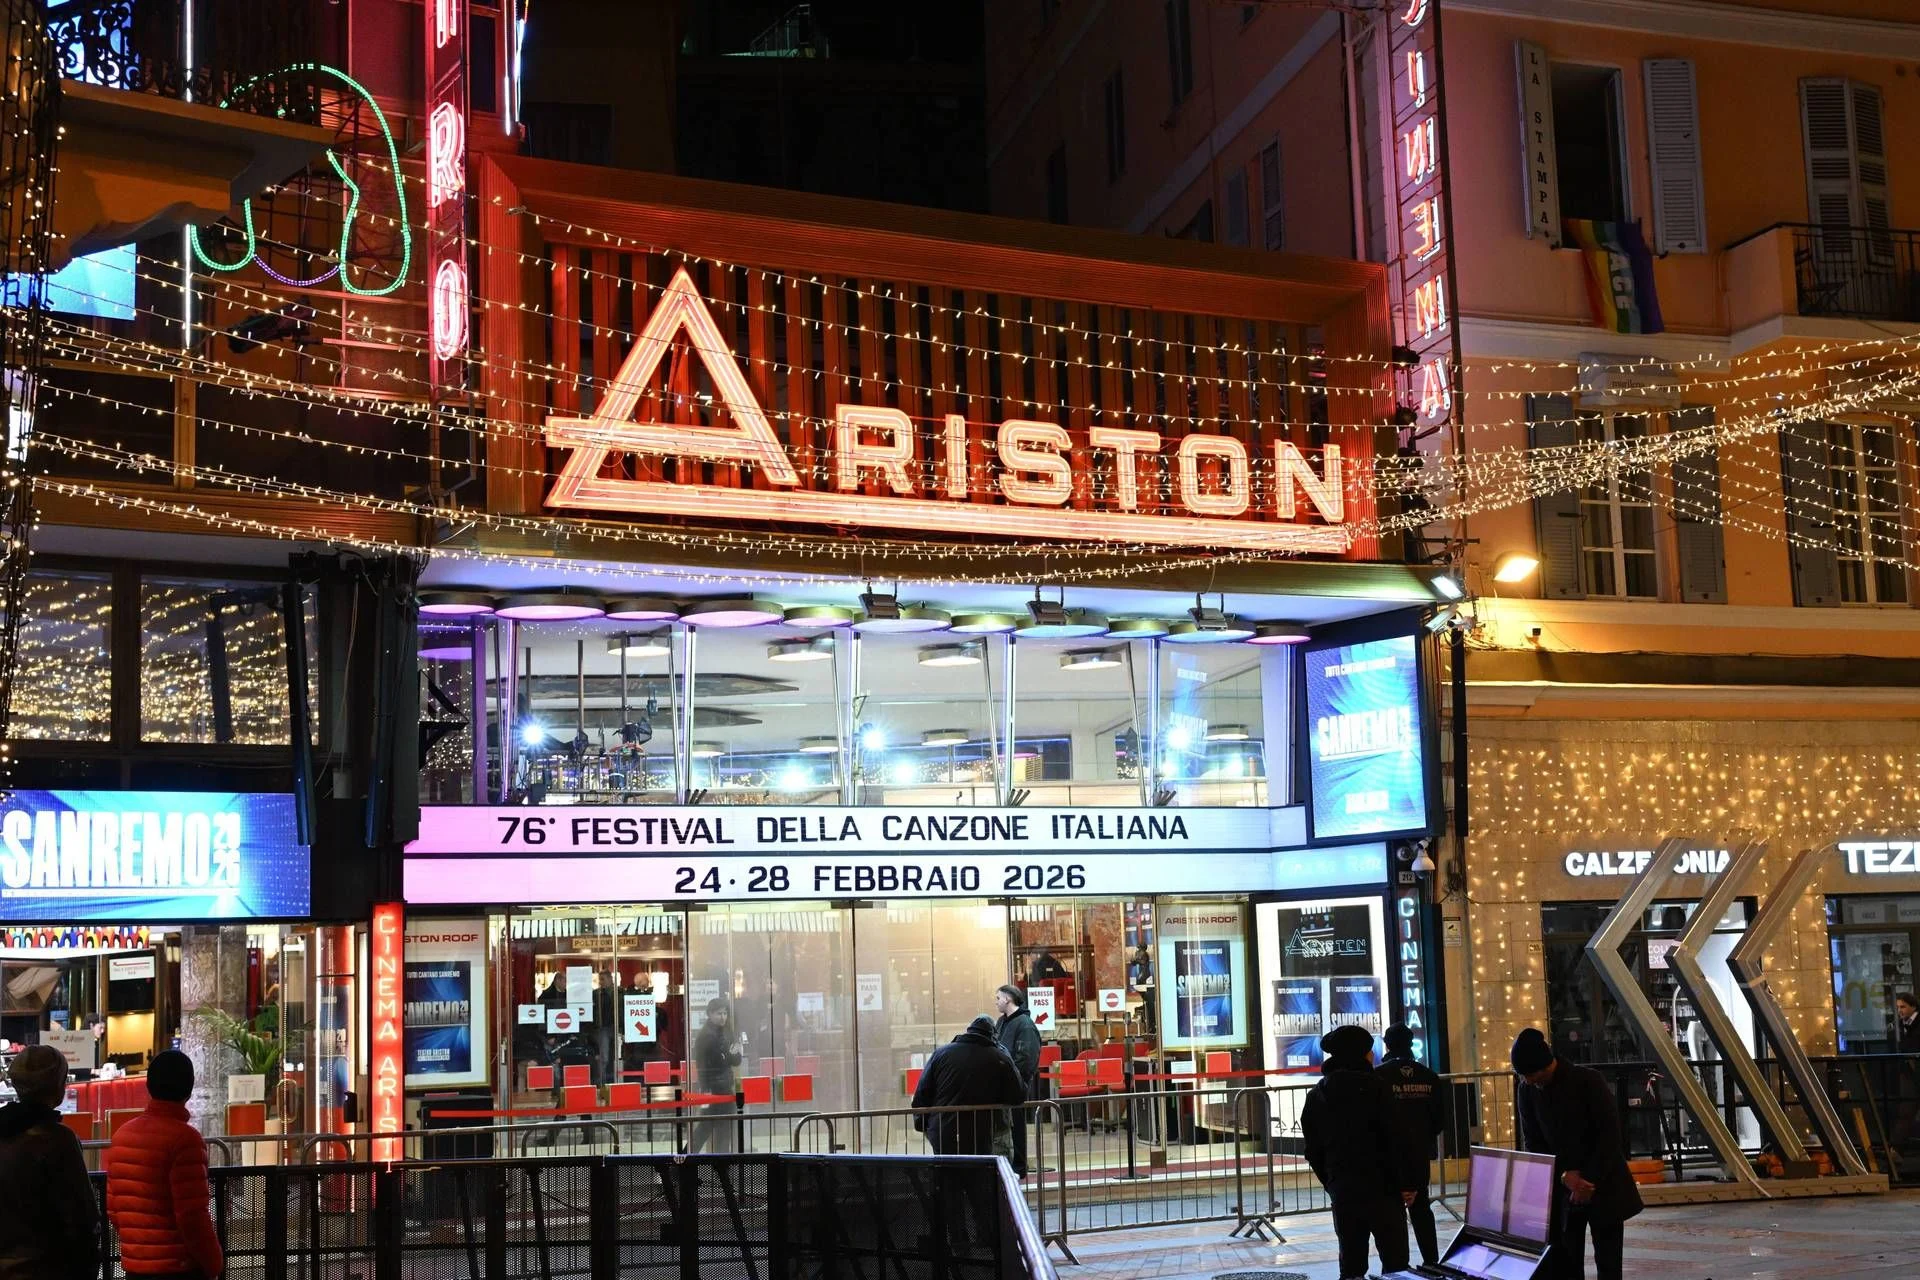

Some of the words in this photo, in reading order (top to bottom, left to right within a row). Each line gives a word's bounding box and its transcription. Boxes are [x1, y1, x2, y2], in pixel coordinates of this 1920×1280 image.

[1531, 52, 1541, 85] LA
[431, 0, 467, 361] RO
[1534, 112, 1549, 224] STAMPA
[545, 266, 1347, 540] ARISTON
[572, 815, 734, 845] FESTIVAL
[757, 815, 862, 843] DELLA
[882, 814, 1029, 842] CANZONE
[1051, 814, 1189, 841] ITALIANA
[2, 810, 211, 888] SANREMO
[1565, 850, 1731, 876] CALZEONIA
[815, 864, 980, 892] FEBBRAIO
[1003, 864, 1087, 890] 2026
[1402, 873, 1414, 881] 212
[1211, 915, 1238, 924] ROOF
[443, 933, 480, 942] ROOF
[574, 937, 637, 947] POLTONISIME
[377, 914, 397, 1040] CINEMA
[1398, 897, 1423, 1029] CINEMA
[630, 1009, 650, 1017] PASS
[1273, 1013, 1314, 1035] SANREMO
[1403, 1083, 1432, 1092] SECURITY
